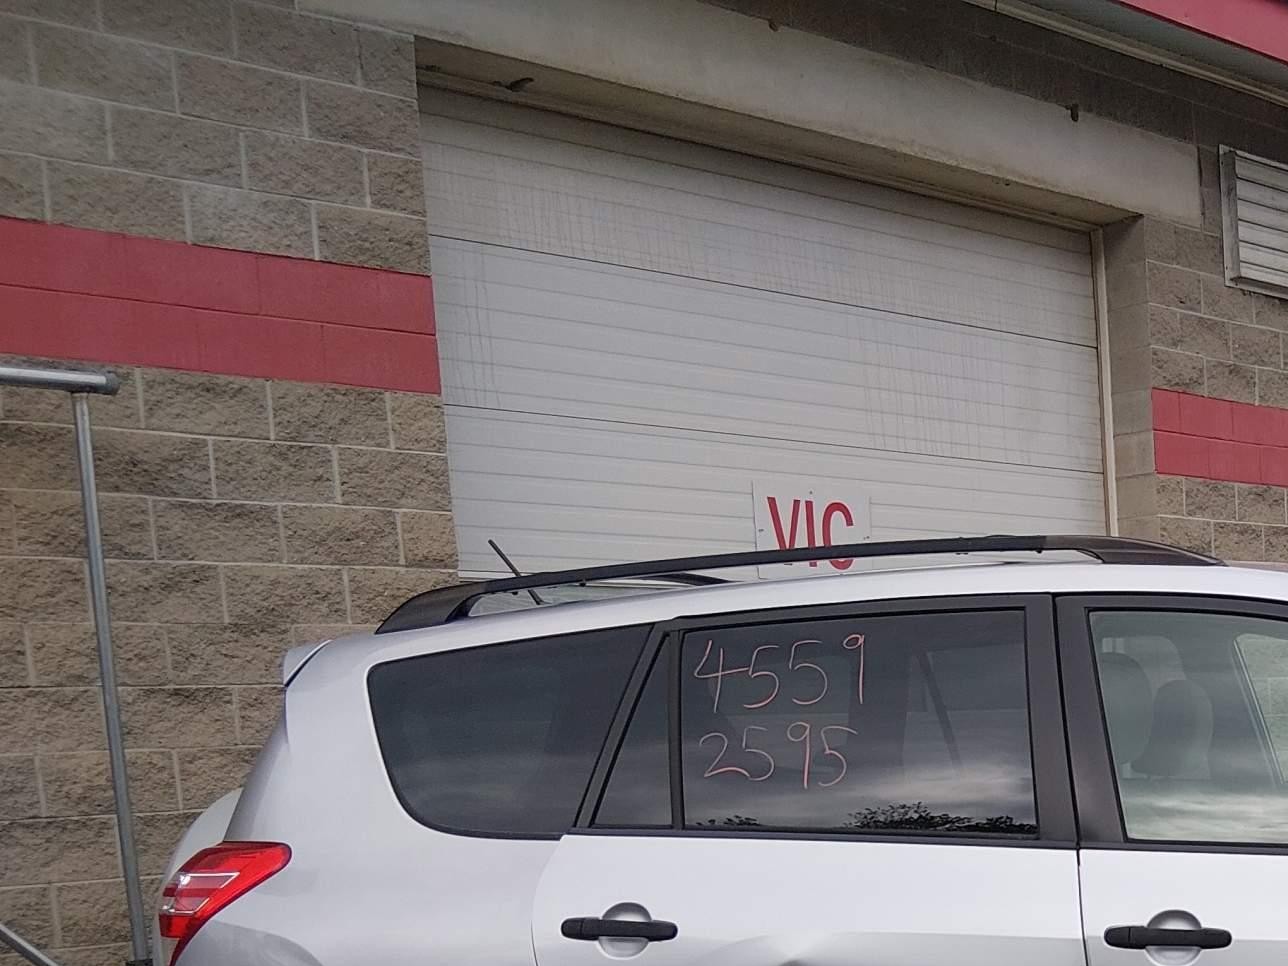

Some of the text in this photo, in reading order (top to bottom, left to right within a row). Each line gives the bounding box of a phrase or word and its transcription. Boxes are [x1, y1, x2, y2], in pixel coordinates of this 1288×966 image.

[767, 496, 854, 570] VIC
[693, 633, 865, 714] 4559
[698, 721, 858, 789] 2595
